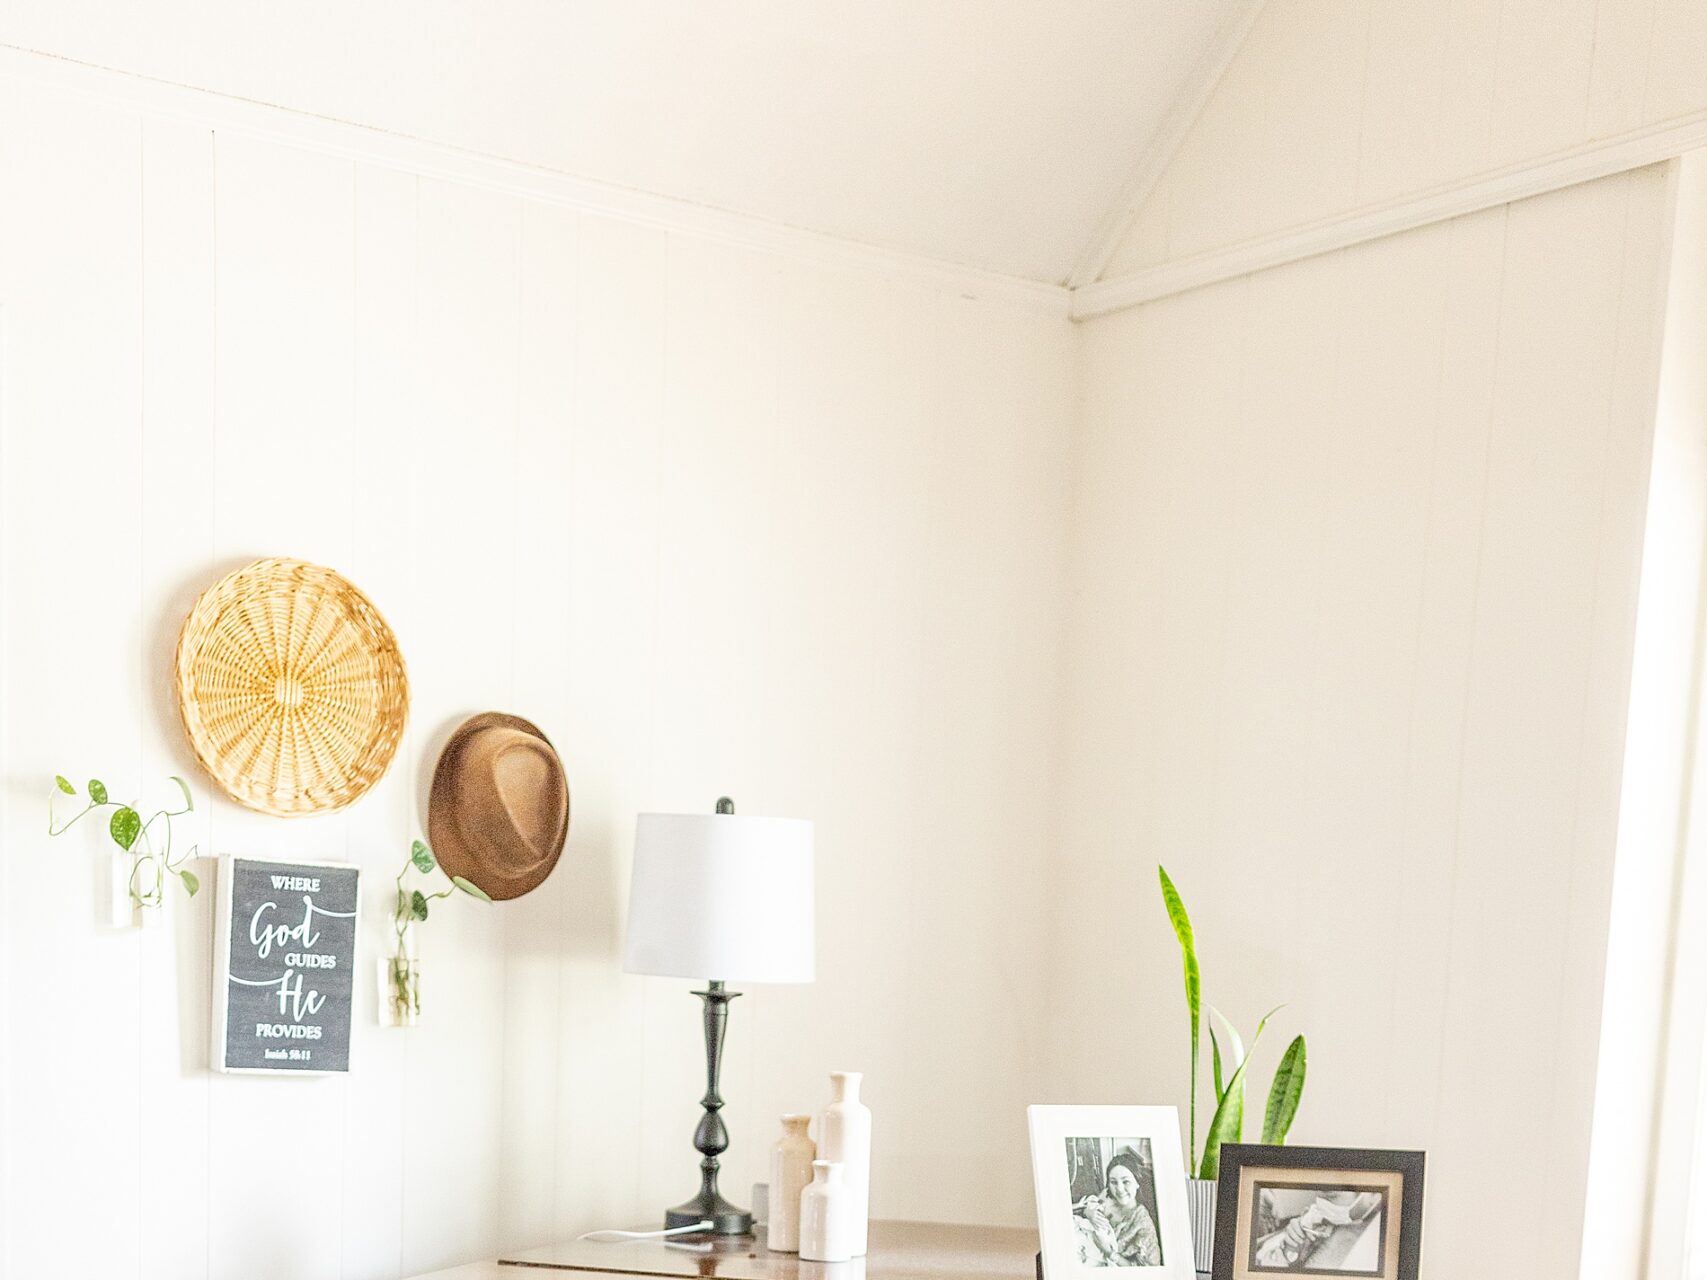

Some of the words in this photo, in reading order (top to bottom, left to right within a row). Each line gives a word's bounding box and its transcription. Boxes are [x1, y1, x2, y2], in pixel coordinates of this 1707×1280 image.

[270, 875, 321, 893] WHERE
[250, 895, 321, 959] God
[284, 953, 337, 969] GUIDES
[276, 969, 327, 1022] He
[255, 1023, 322, 1040] PROVIDES
